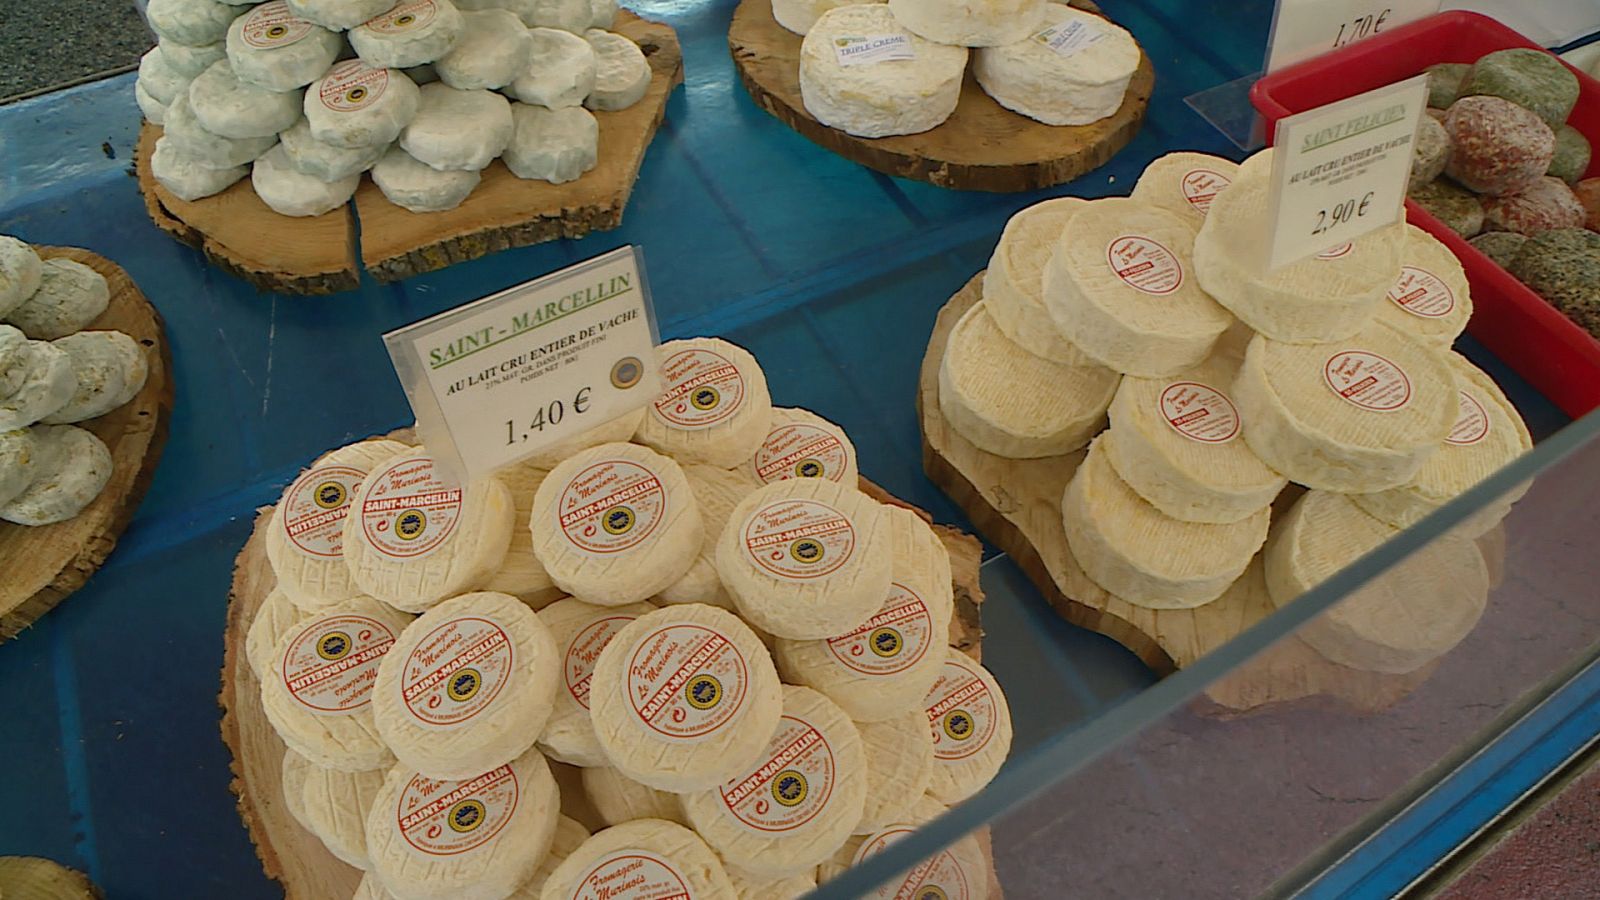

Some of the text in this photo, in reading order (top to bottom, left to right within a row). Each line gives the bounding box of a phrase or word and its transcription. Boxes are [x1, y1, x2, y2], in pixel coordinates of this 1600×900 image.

[1333, 9, 1390, 47] 1,70 €
[1302, 123, 1345, 149] SAINT
[1312, 191, 1374, 234] 2,90 €
[430, 326, 494, 366] SAINT
[511, 272, 631, 334] MARCELLIN
[447, 309, 639, 396] AU LAIT CRU ENTIER DE VACHE
[505, 387, 592, 446] 1,40 €
[760, 438, 839, 475] SAINT-MARCELLIN
[365, 491, 460, 511] SAINT-MARCELLIN
[562, 478, 658, 526] SAINT-MARCELLIN
[749, 520, 848, 548] SAINT-MARCELLIN
[405, 633, 504, 700] SAINT-MARCELLIN
[642, 637, 724, 719] SAINT-MARCELLIN
[726, 730, 819, 805] SAINT-MARCELLIN
[402, 766, 509, 828] SAINT-MARCELLIN
[590, 859, 645, 890] Fromagerie
